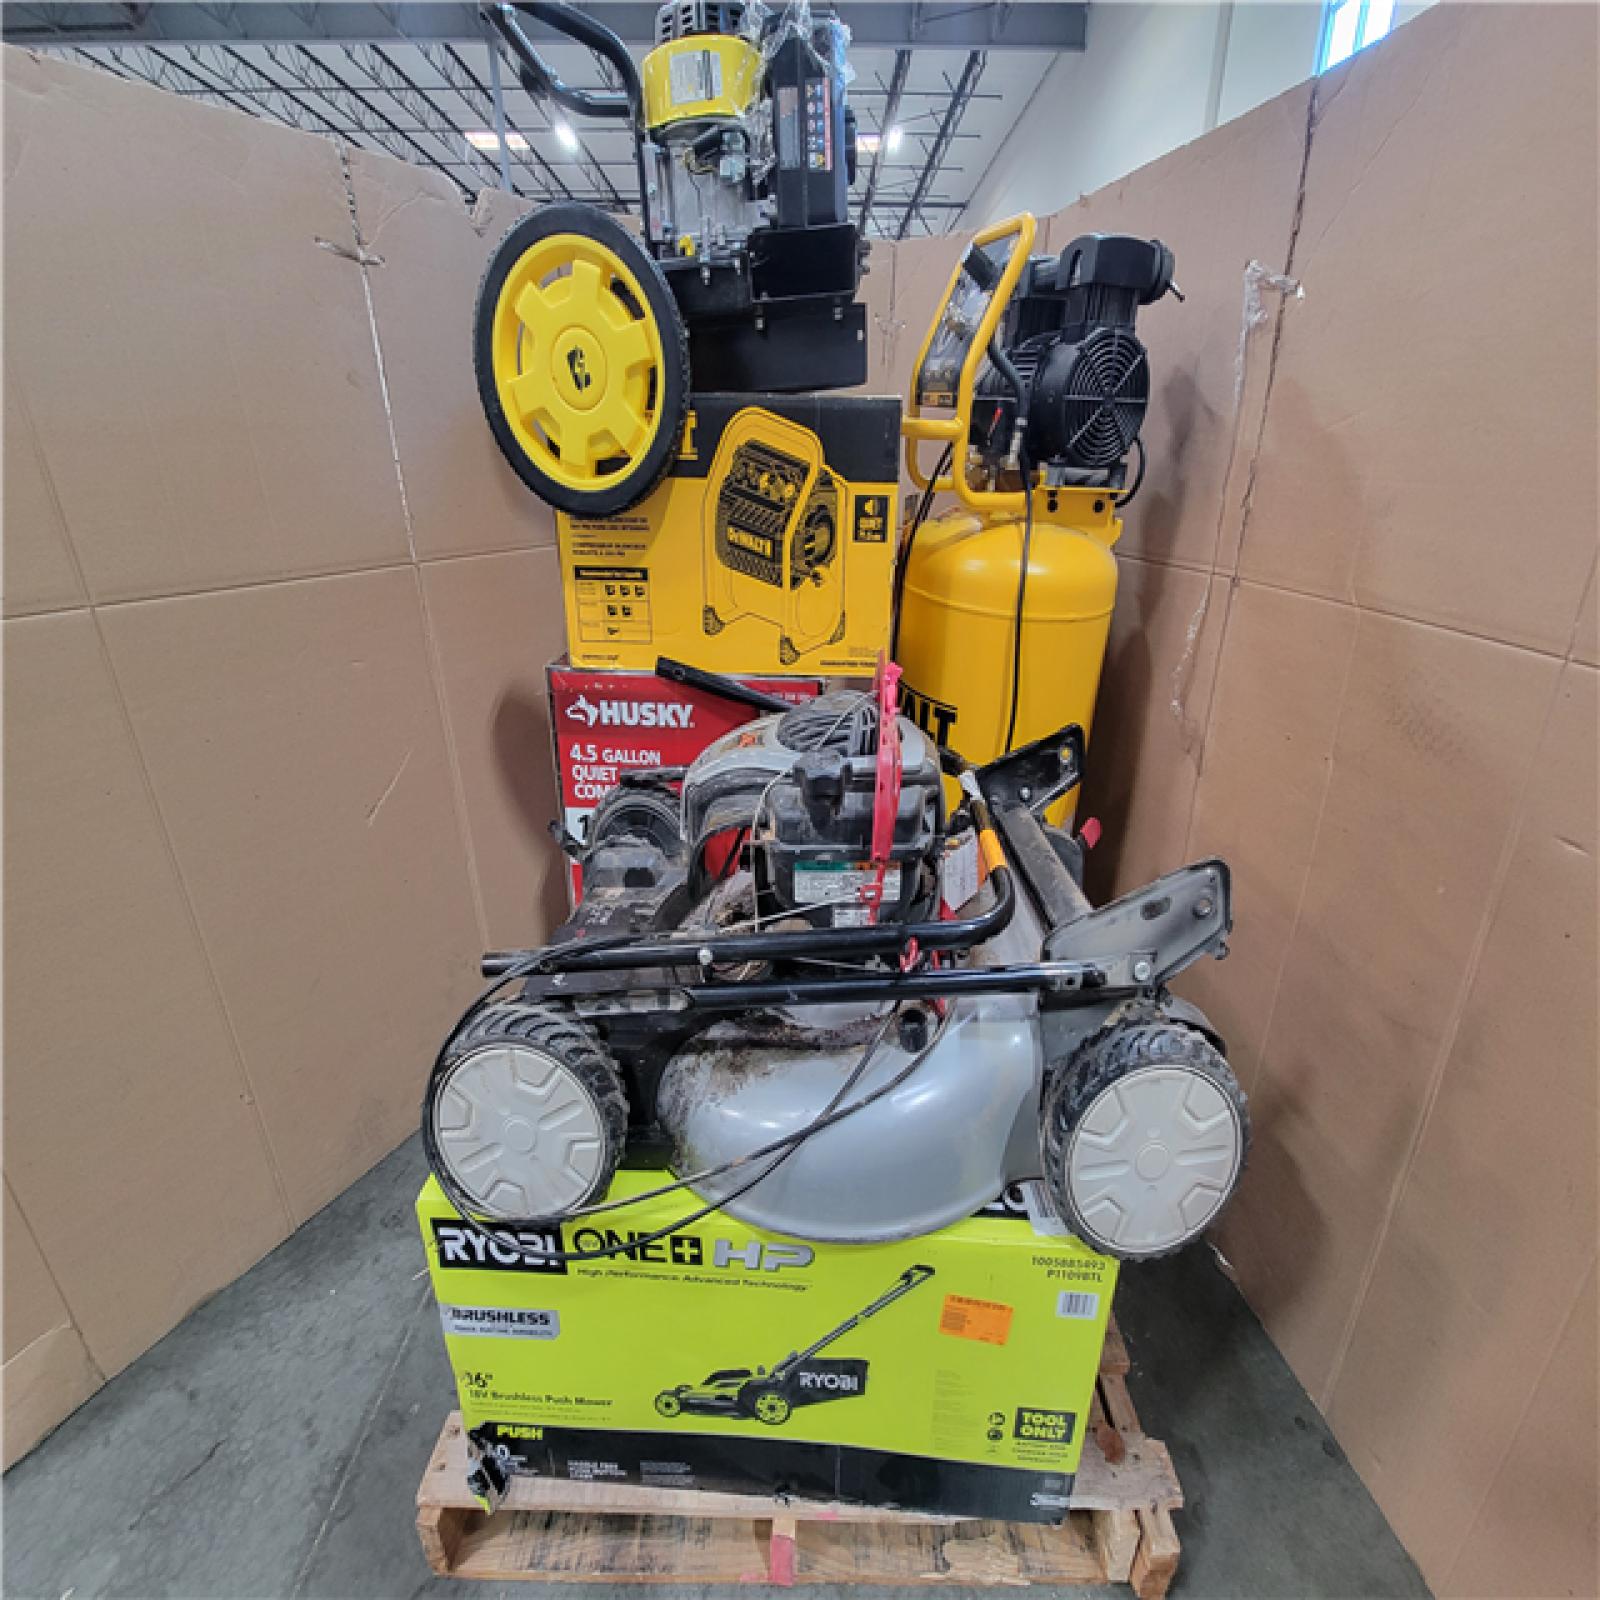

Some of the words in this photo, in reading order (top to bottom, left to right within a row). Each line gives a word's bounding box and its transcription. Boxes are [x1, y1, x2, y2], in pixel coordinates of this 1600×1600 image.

[599, 699, 693, 728] HUSKY
[569, 743, 598, 763] 4.5
[602, 748, 661, 766] GALLON
[572, 764, 618, 783] QUIET
[713, 1239, 816, 1272] HP
[799, 1371, 859, 1391] RYOBI
[1022, 1412, 1066, 1426] TOOL
[497, 1424, 544, 1441] PUSH
[1020, 1424, 1067, 1439] ONLY
